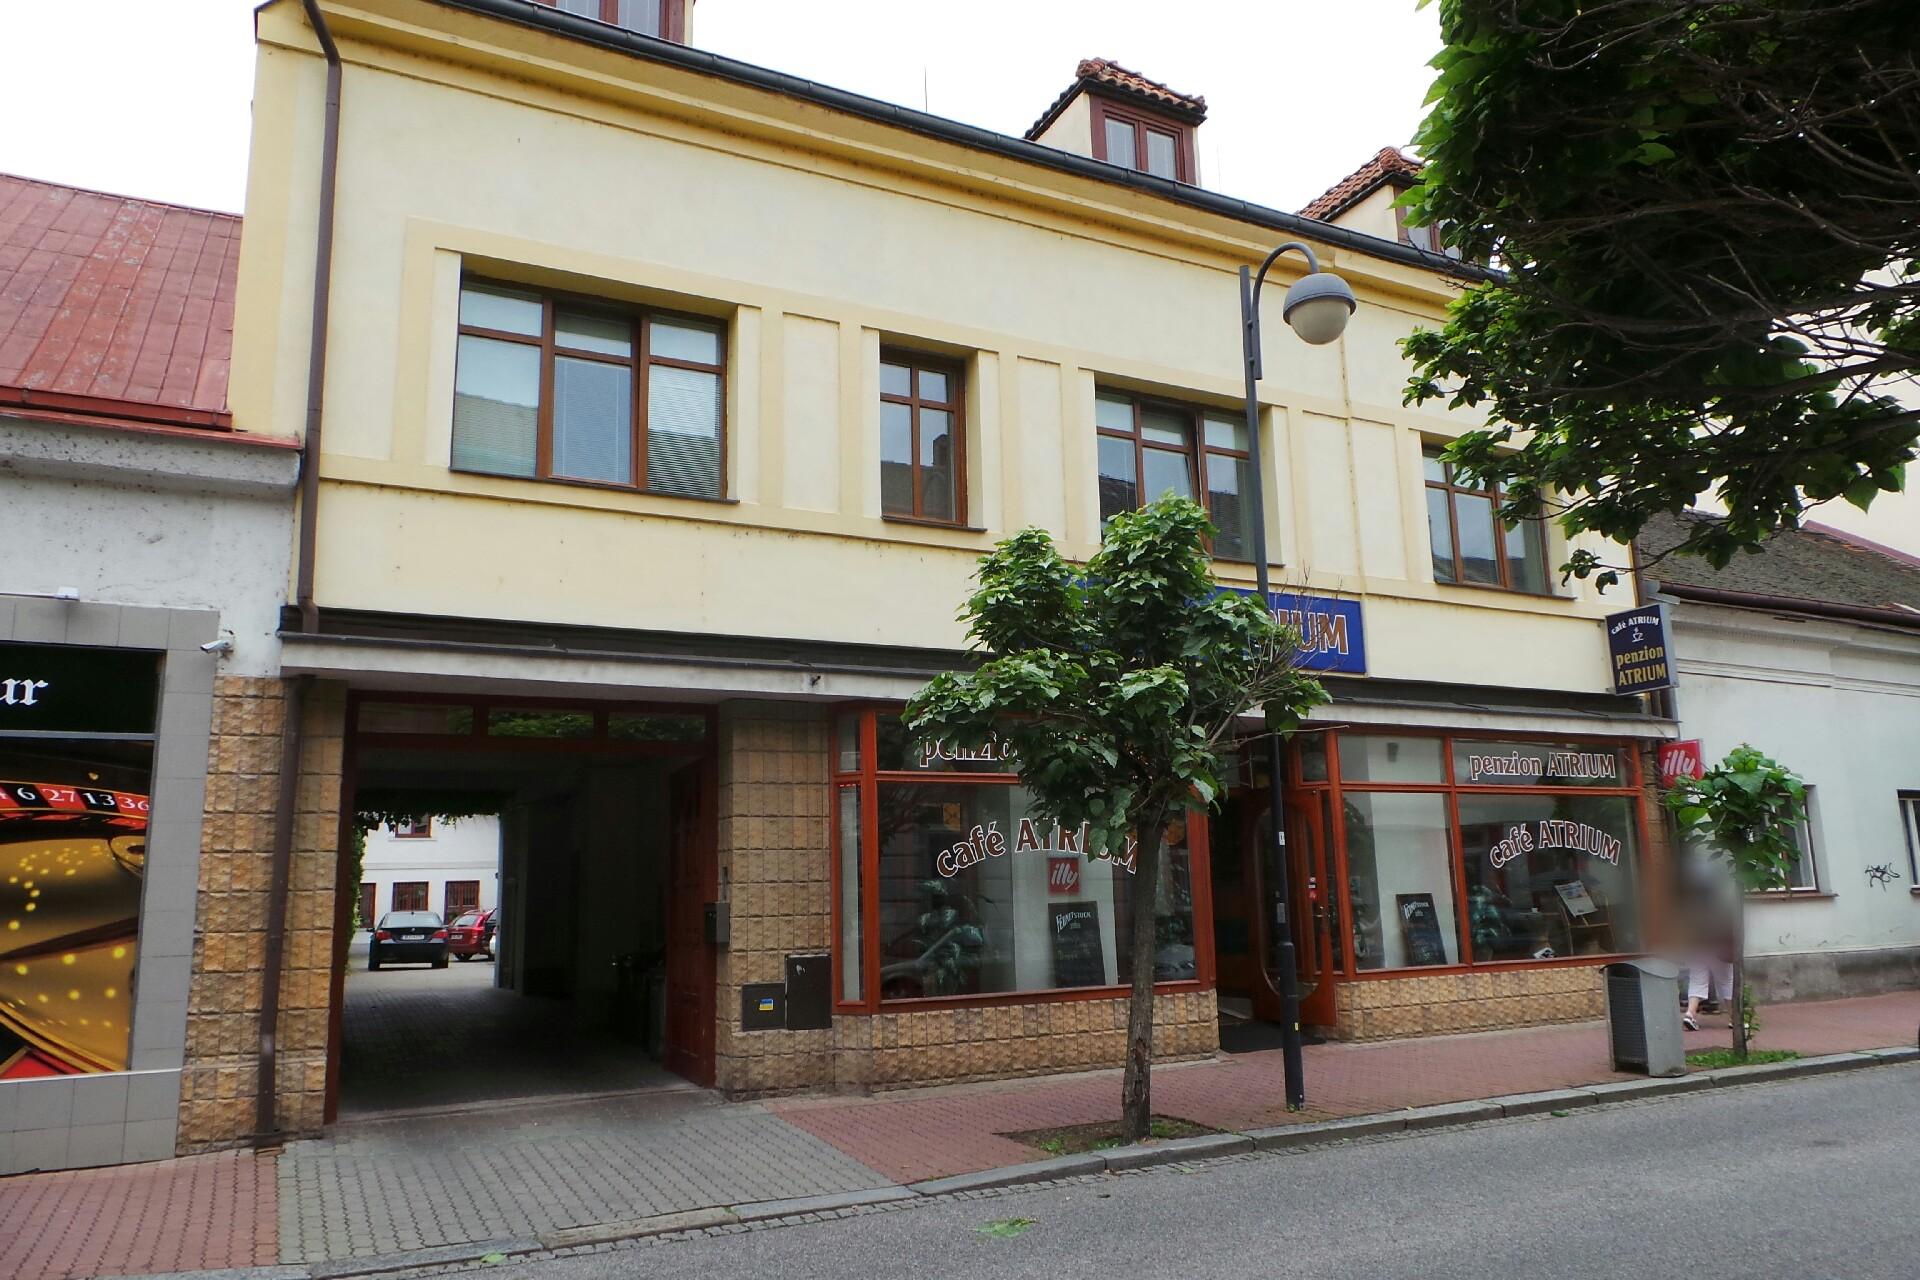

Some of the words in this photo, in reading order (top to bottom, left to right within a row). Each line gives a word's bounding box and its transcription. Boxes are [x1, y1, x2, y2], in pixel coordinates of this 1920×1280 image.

[1628, 616, 1660, 626] ATRIUM
[1616, 645, 1664, 669] penzion
[1619, 663, 1667, 686] ATRIUM
[1470, 751, 1543, 780] penzion
[1547, 752, 1616, 778] ATRIUM
[1663, 749, 1696, 779] illy
[17, 787, 36, 801] 6
[42, 788, 75, 803] 27
[83, 792, 116, 806] 13
[118, 796, 149, 811] 36
[936, 821, 1006, 878] café
[1489, 823, 1534, 869] café
[1539, 820, 1621, 866] ATRIUM
[1051, 862, 1079, 890] illy
